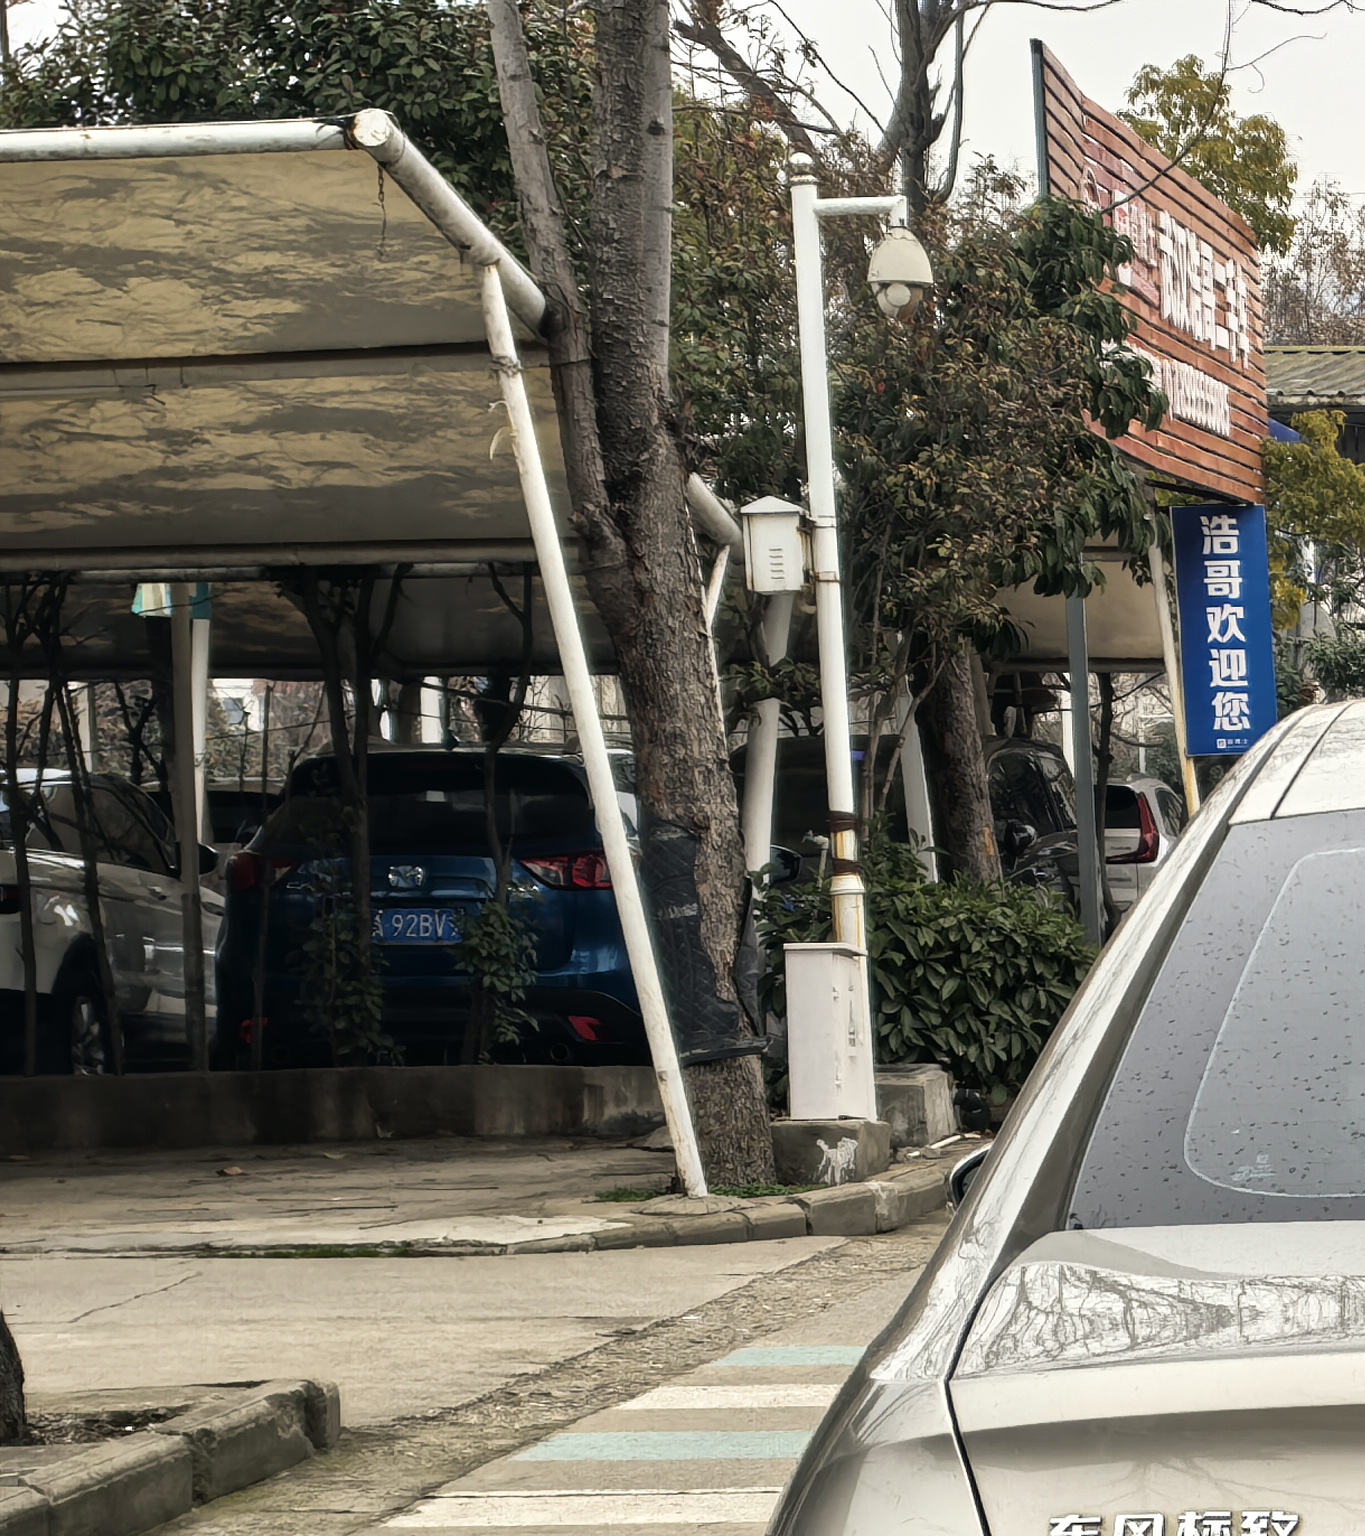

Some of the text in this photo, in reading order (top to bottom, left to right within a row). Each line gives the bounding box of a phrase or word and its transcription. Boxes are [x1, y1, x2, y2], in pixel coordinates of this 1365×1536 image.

[1199, 514, 1251, 732] 浩哥欢迎您
